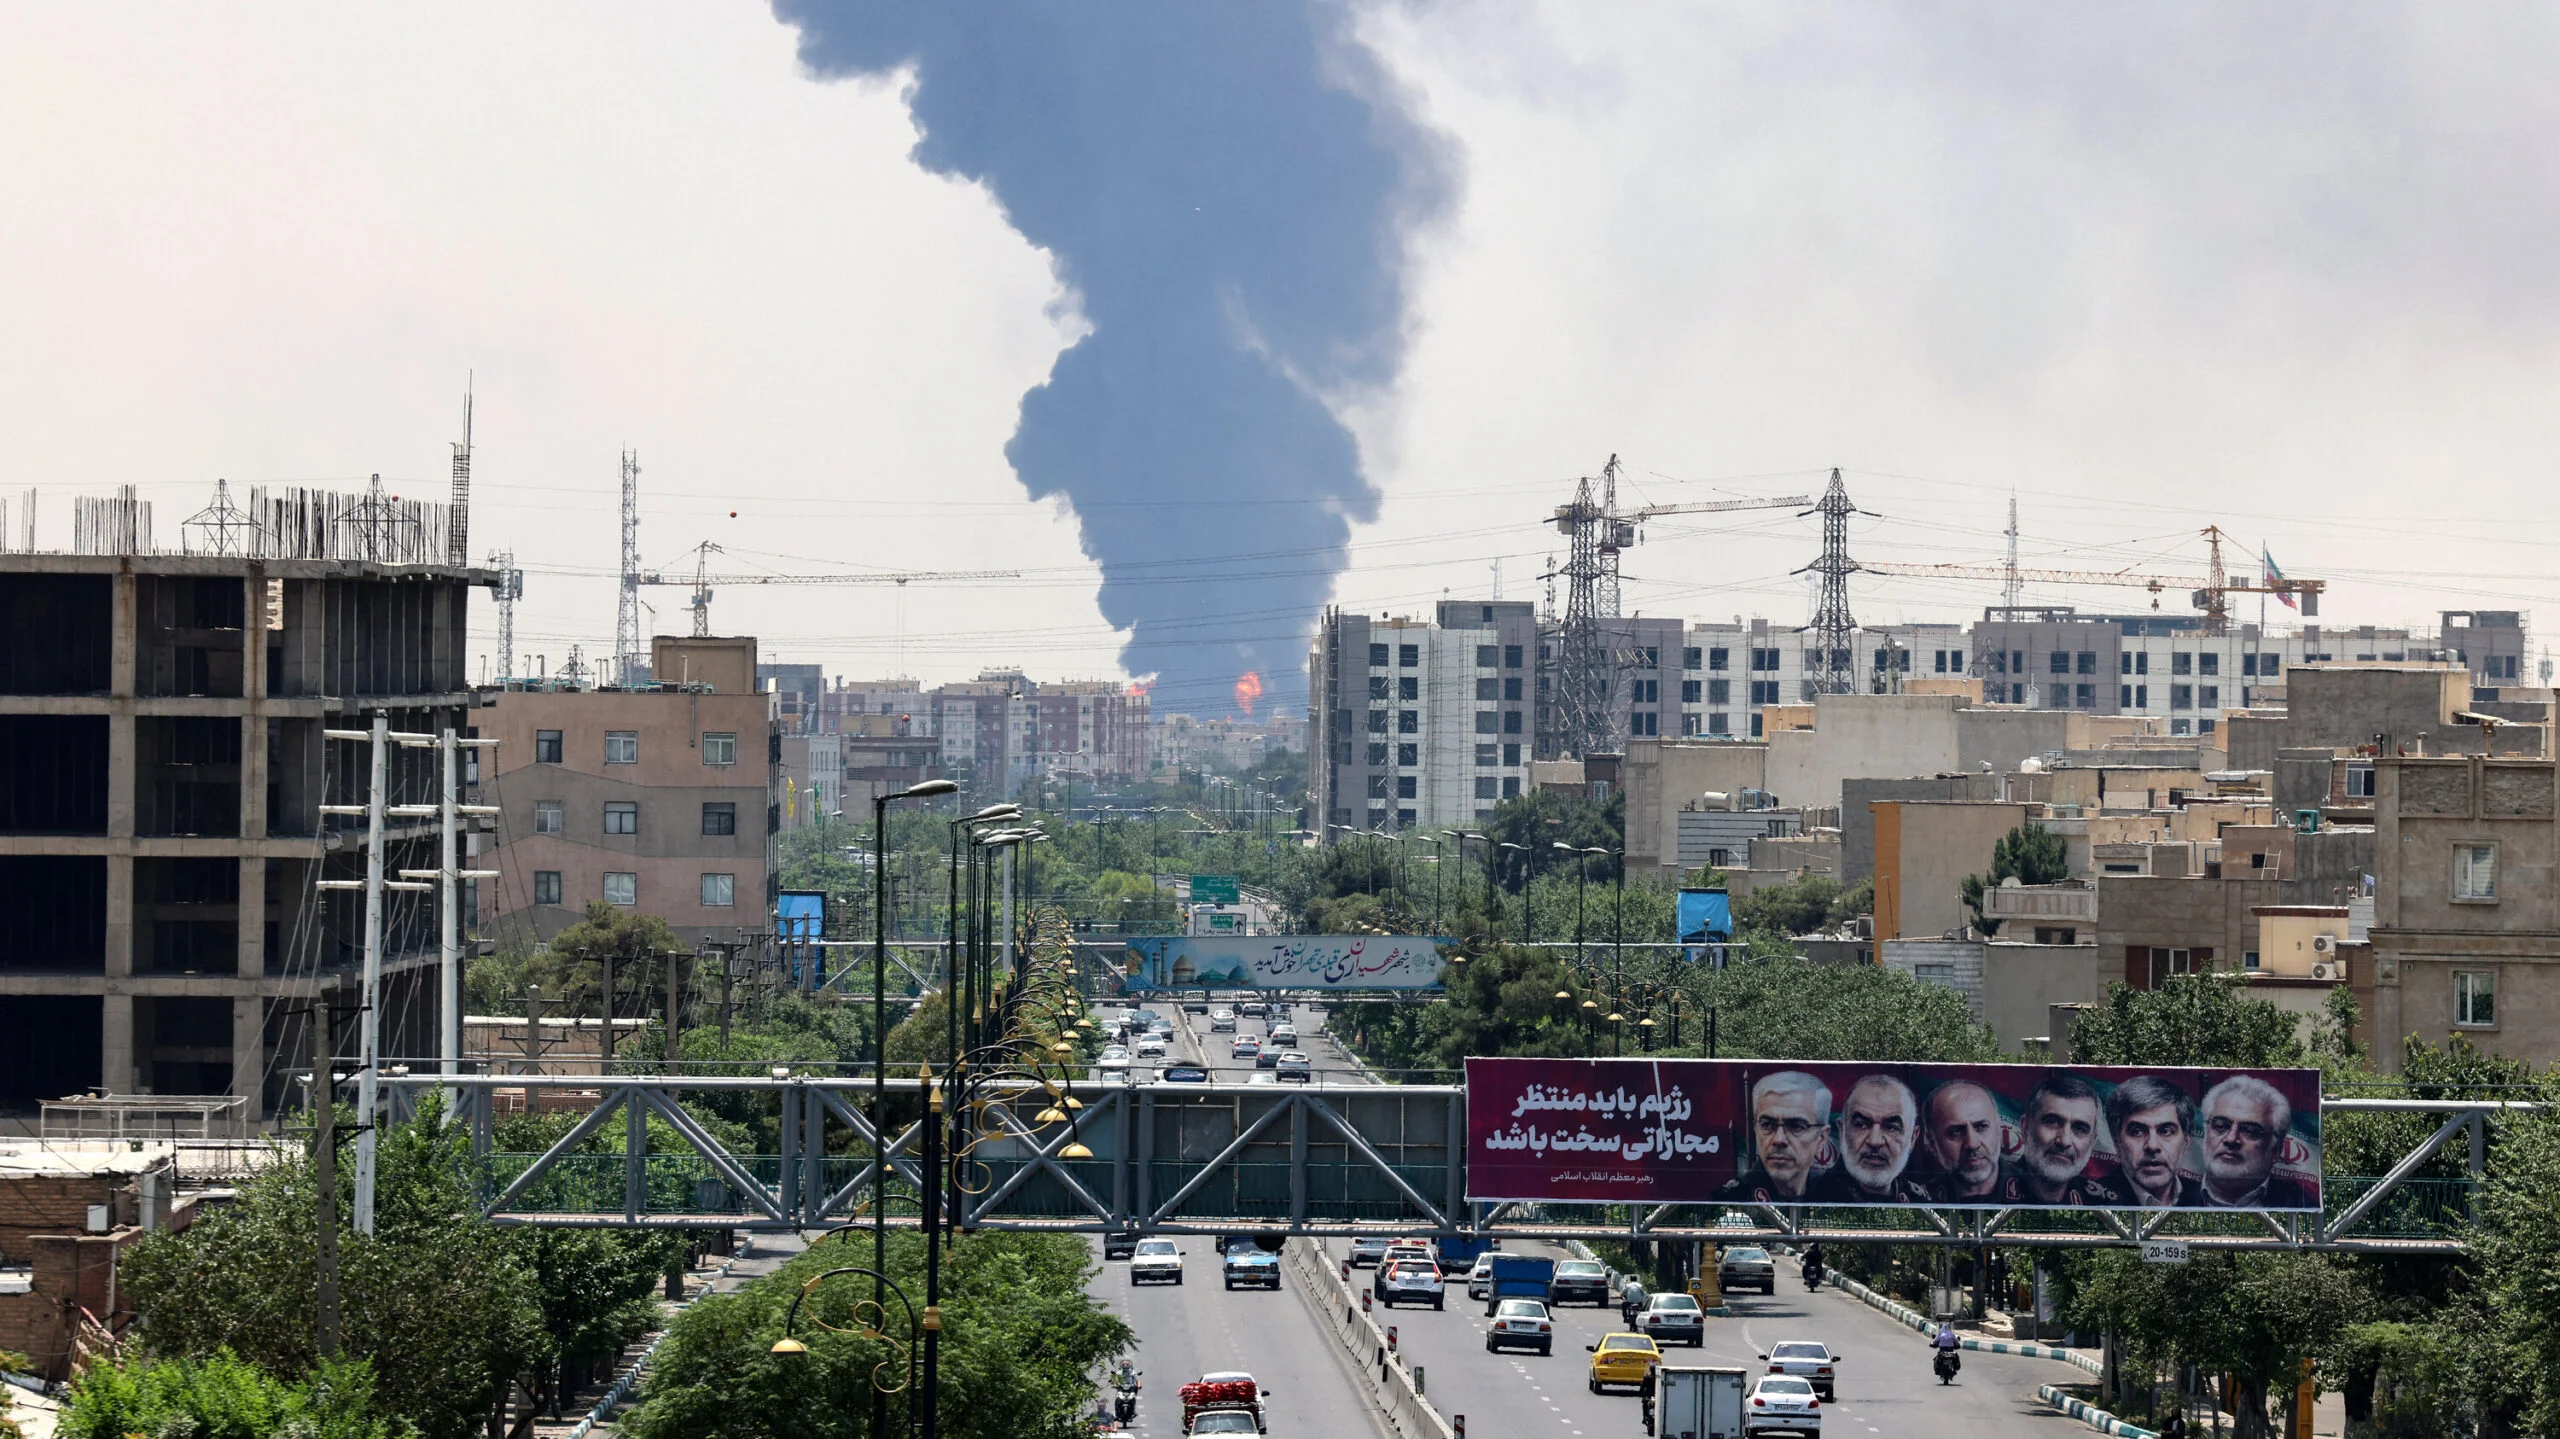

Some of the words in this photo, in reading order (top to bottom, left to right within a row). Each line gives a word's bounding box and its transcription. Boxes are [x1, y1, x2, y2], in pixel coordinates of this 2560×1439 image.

[1254, 945, 1288, 971] آمدید
[1270, 949, 1296, 975] خوش
[1350, 938, 1400, 977] شهیدان
[1380, 949, 1410, 976] شهر
[1511, 1083, 1588, 1118] منتظر
[1588, 1086, 1637, 1120] باید
[1639, 1085, 1692, 1121] رژیم
[1485, 1122, 1549, 1159] باشد
[1550, 1124, 1621, 1153] سخت
[1622, 1126, 1720, 1161] مجازاتی
[1550, 1171, 1582, 1183] اسلامی
[1582, 1172, 1609, 1183] انقلاب
[1609, 1171, 1636, 1184] معظم
[1635, 1172, 1654, 1185] رهبر
[2150, 1246, 2179, 1258] 20-159
